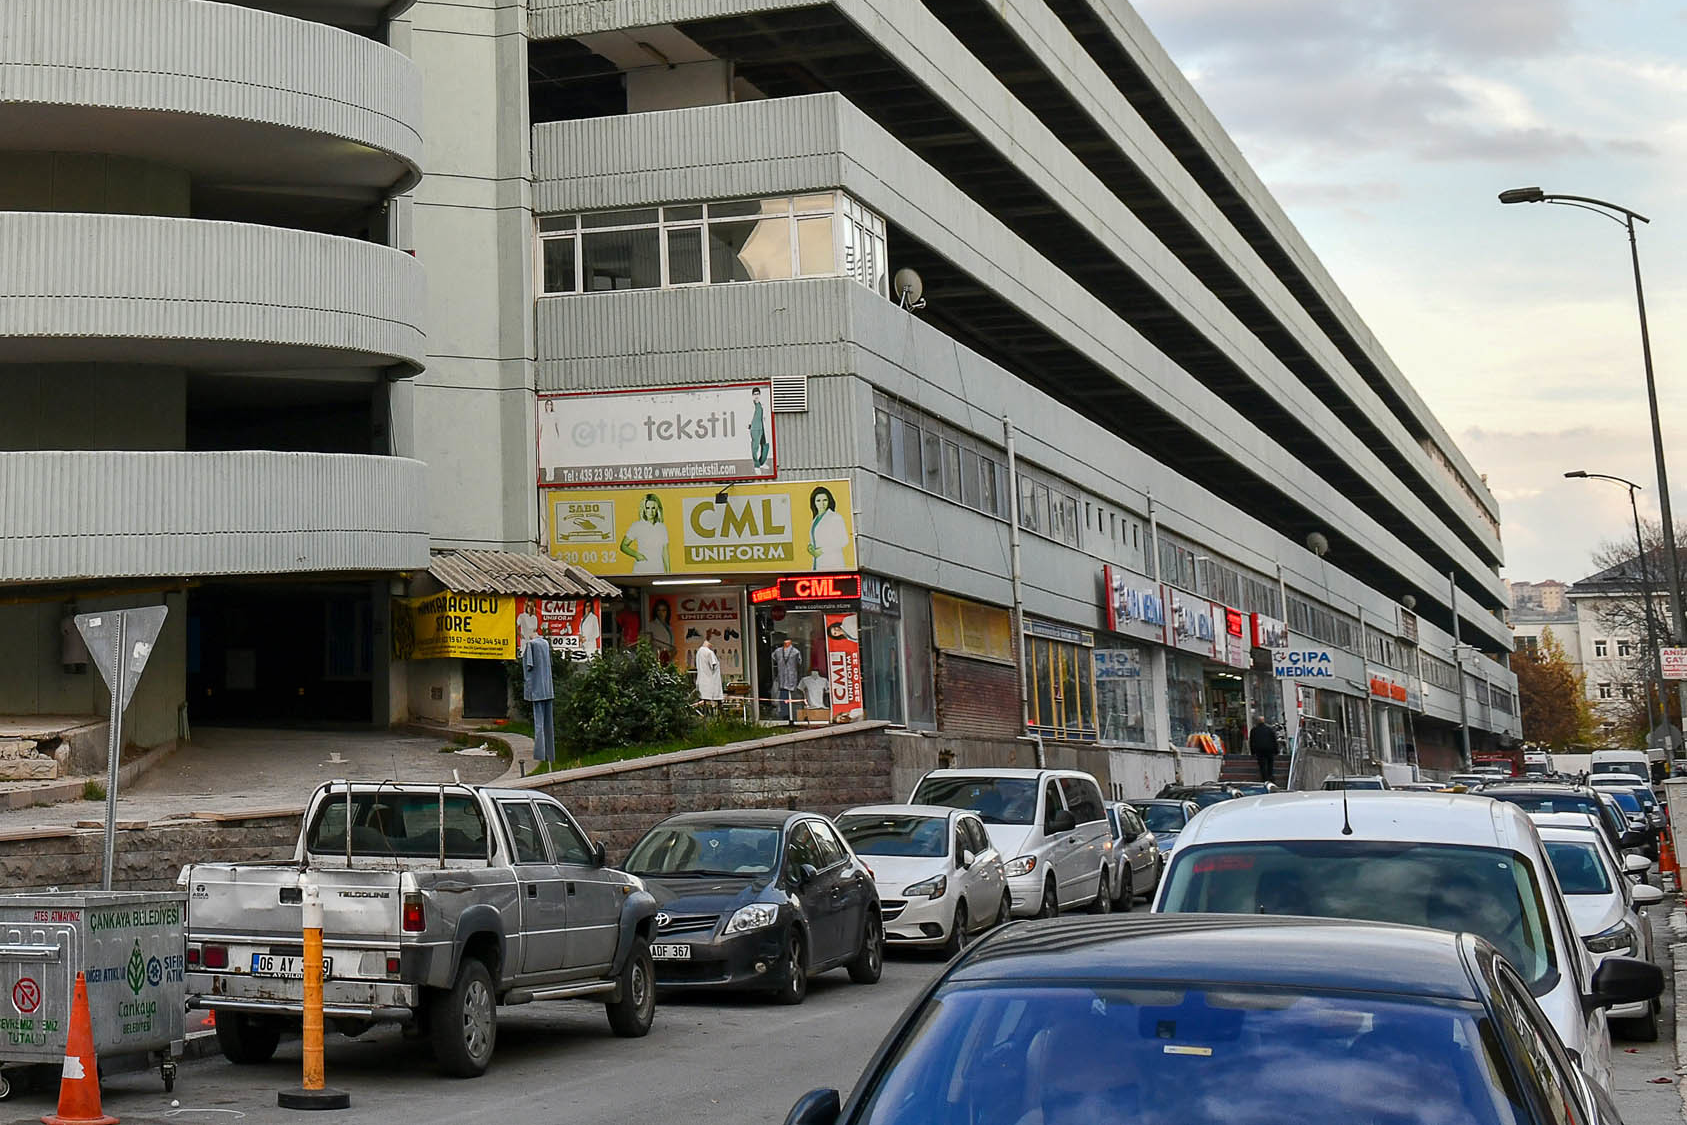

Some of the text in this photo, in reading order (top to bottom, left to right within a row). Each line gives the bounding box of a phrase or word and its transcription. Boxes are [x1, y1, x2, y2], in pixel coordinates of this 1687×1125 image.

[644, 411, 735, 441] tekstil
[563, 470, 574, 482] Tel
[579, 468, 593, 482] 435
[594, 468, 603, 481] 23
[604, 468, 613, 481] 90
[618, 467, 632, 480] 434
[633, 466, 642, 480] 32
[643, 466, 653, 479] 02
[661, 462, 736, 479] www.etiptekstil.com
[568, 504, 600, 513] SABO
[690, 498, 785, 539] CML
[601, 550, 617, 563] 32
[691, 544, 785, 562] UNIFORM
[795, 579, 842, 597] CML
[544, 600, 574, 613] CML
[681, 597, 733, 612] CML
[436, 616, 472, 633] STORE
[1289, 651, 1331, 665] ÇIPA
[832, 654, 846, 701] CML
[846, 655, 854, 701] UNIFORM
[1275, 664, 1333, 677] MEDİKAL
[90, 904, 180, 934] ÇANKAYA BELEDİYESİ
[672, 946, 689, 957] 367
[164, 955, 184, 970] SIFIR
[260, 956, 274, 971] 06
[279, 957, 295, 972] AY
[166, 969, 184, 983] ATIK
